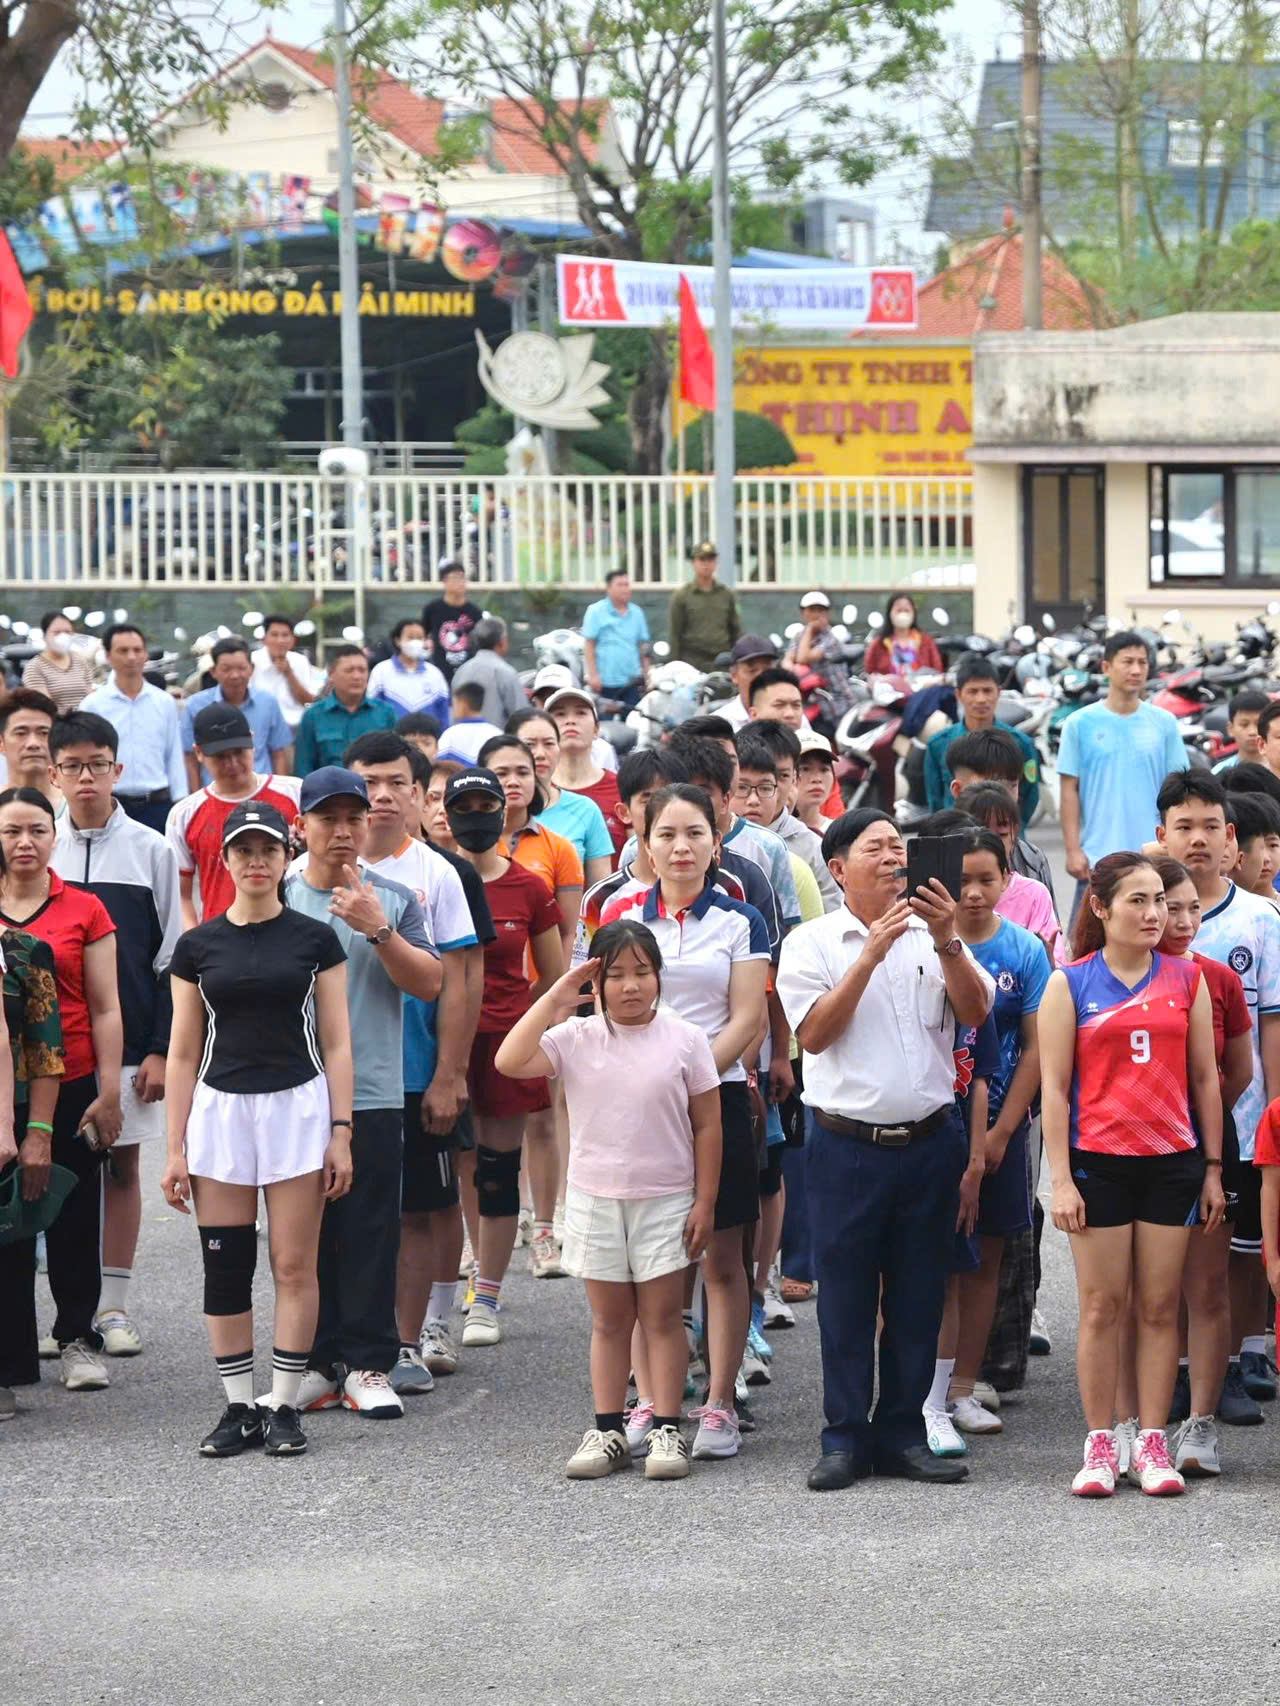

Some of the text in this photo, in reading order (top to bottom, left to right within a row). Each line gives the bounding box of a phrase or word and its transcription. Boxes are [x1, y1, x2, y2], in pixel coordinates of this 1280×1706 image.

[283, 280, 328, 316] ĐÁ
[394, 291, 474, 316] MINH
[811, 361, 852, 385] TY
[861, 361, 951, 385] TNHH
[761, 401, 919, 446] THỊNH
[1130, 1029, 1151, 1064] 9
